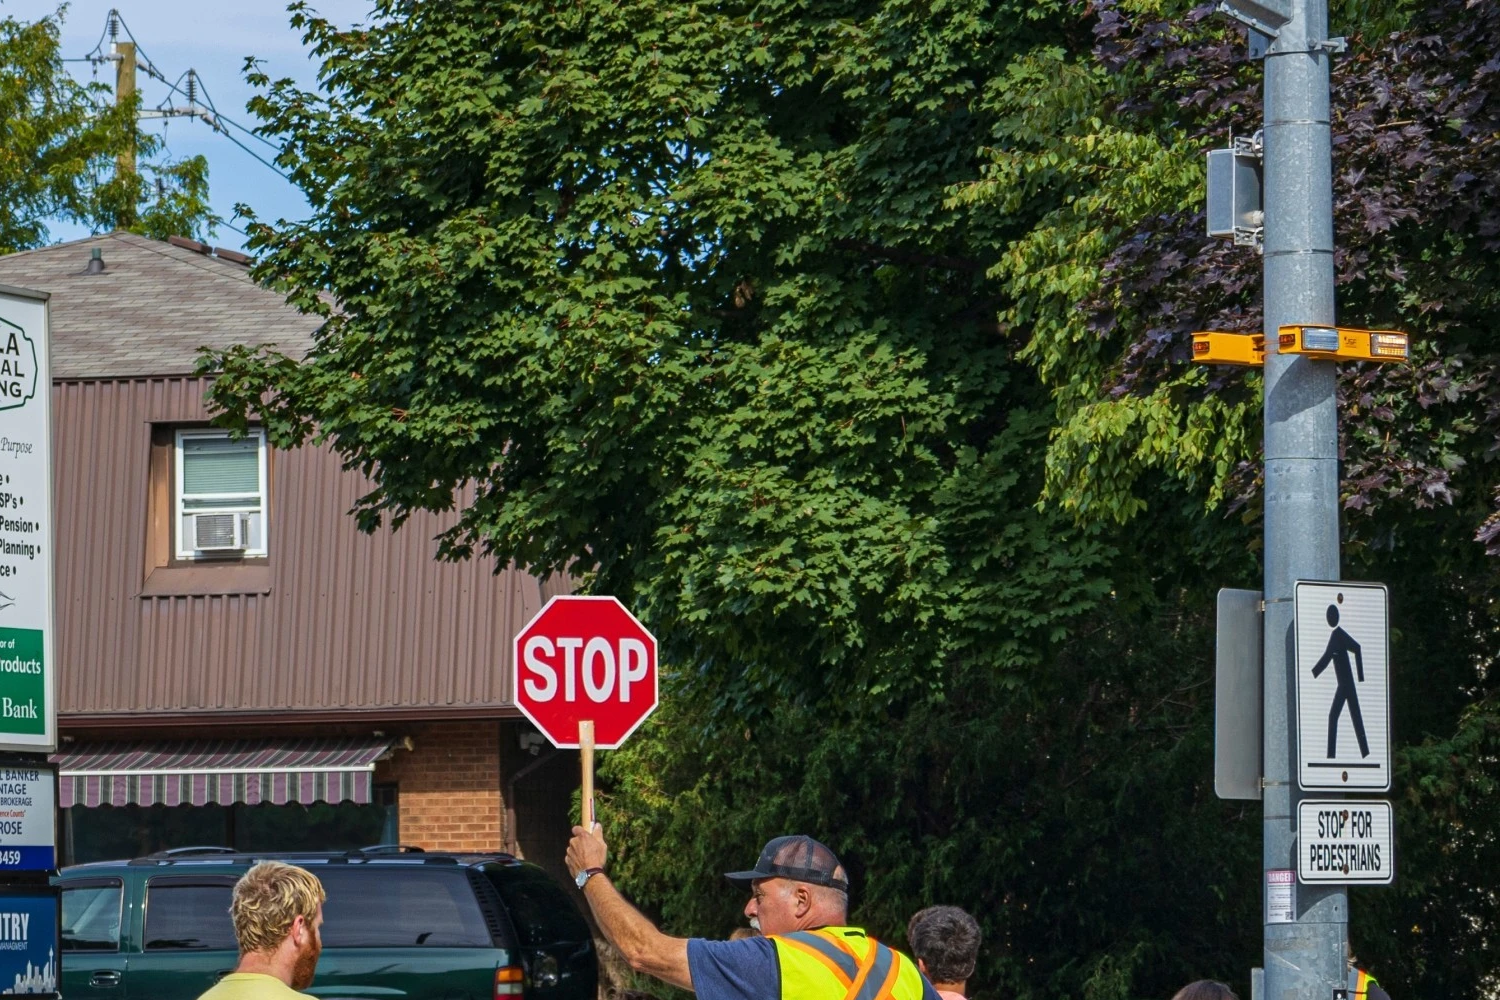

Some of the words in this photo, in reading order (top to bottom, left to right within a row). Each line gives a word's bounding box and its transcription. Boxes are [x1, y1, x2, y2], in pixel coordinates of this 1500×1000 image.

[0, 436, 33, 459] Purpose
[8, 639, 15, 649] of
[524, 635, 648, 703] STOP
[2, 697, 38, 719] Bank
[6, 770, 39, 781] BANKER
[1, 797, 32, 806] BROKERAGE
[1318, 811, 1346, 838] STOP
[1352, 811, 1372, 838] FOR
[1310, 844, 1381, 871] PEDESTRIANS
